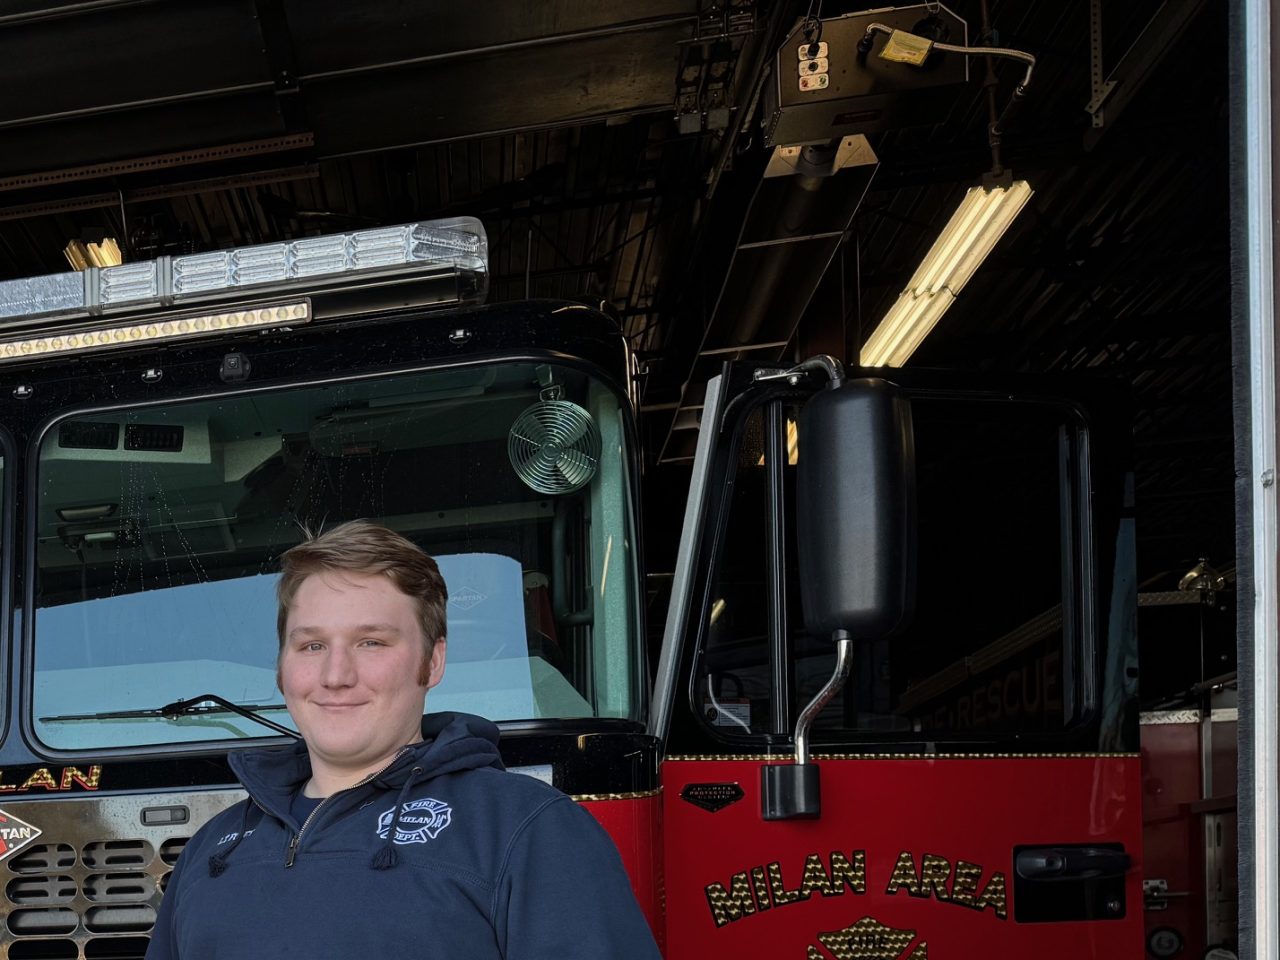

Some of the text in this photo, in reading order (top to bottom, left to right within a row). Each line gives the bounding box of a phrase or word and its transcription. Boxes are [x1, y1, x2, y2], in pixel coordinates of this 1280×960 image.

[410, 800, 437, 809] FIRE
[705, 850, 1008, 928] MILAN AREA
